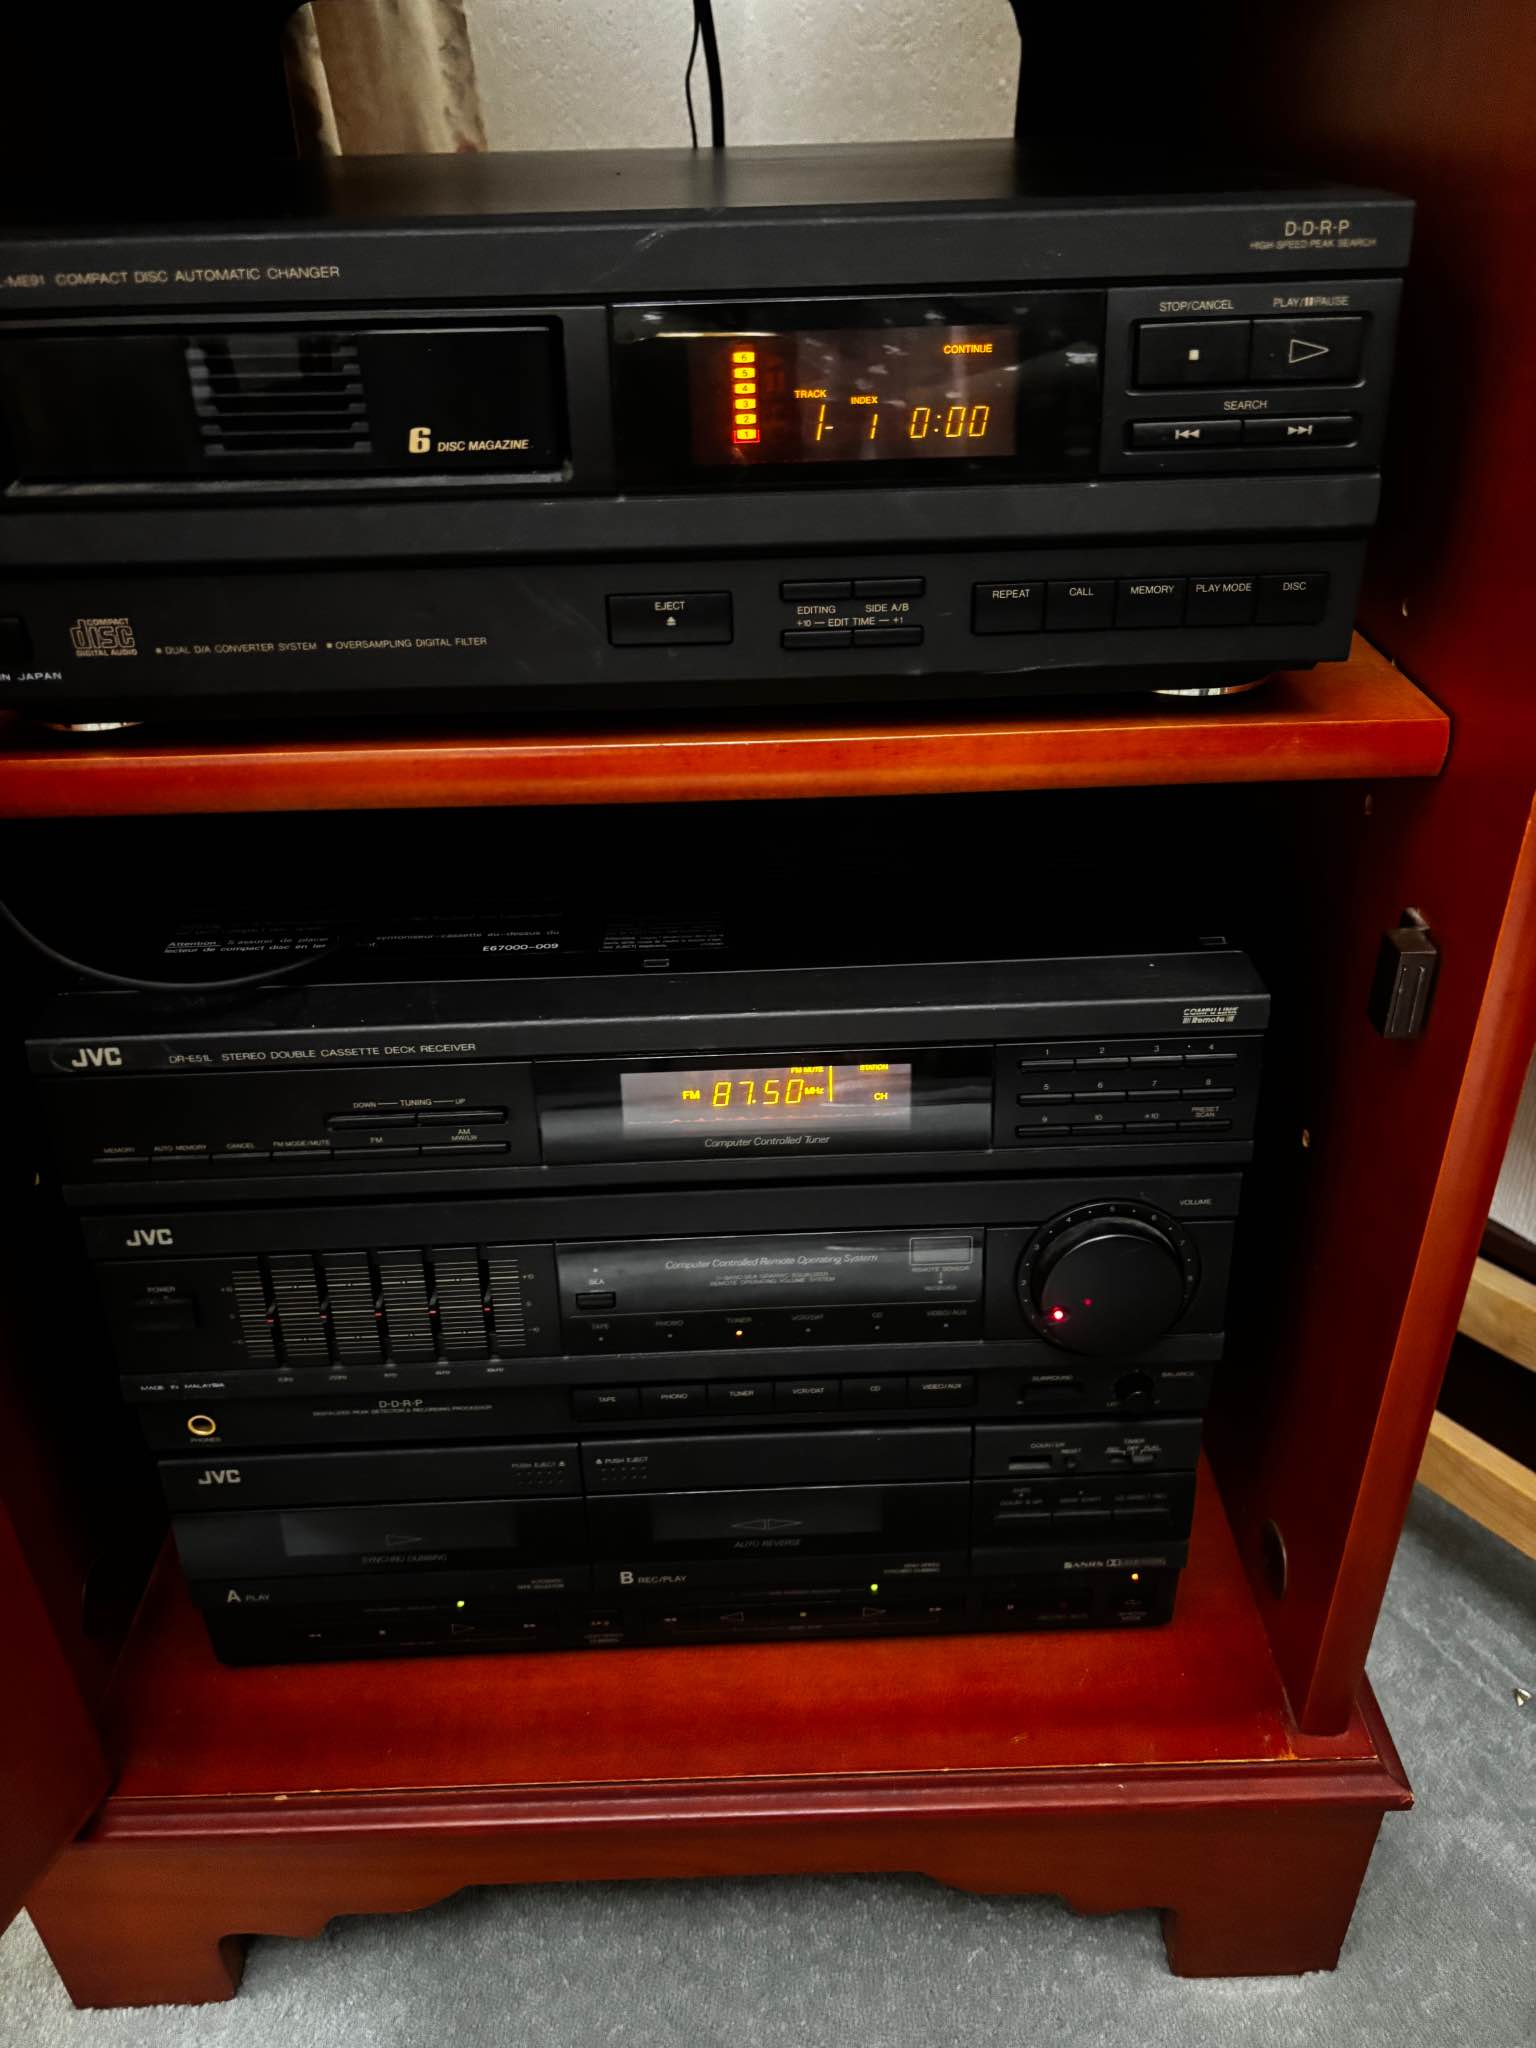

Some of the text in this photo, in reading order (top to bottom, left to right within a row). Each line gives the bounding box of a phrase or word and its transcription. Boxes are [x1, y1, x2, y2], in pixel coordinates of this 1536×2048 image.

[54, 271, 129, 287] COMPACT
[133, 269, 169, 284] DISC
[175, 267, 261, 283] AUTOMATIC
[266, 265, 341, 281] CHANGER
[1159, 299, 1235, 312] STOP/CANCEL
[943, 343, 993, 355] CONTINUE
[794, 389, 827, 399] TRACK
[850, 396, 878, 405] INDEX
[1223, 400, 1268, 411] SEARCH
[909, 405, 990, 439] 0:00
[408, 427, 530, 454] 6 DISC MAGAZINE
[1068, 586, 1095, 598] CALL
[1130, 584, 1176, 595] MEMORY
[1195, 582, 1252, 593] PLAY MODE
[1282, 580, 1307, 592] DISC
[992, 588, 1031, 600] REPEAT
[654, 601, 685, 612] EJECT
[797, 605, 837, 615] EDITING
[865, 602, 910, 613] SIDE A/B
[827, 618, 849, 627] EDIT
[853, 616, 876, 626] TIME
[164, 641, 318, 655] DUAL D/A CONVERTER SYSTEM
[335, 635, 488, 650] OVERSAMPLING DIGITAL FILTER
[75, 648, 139, 657] DIGITAL AUDIO
[16, 671, 64, 682] JAPAN
[481, 942, 560, 953] E67000-009
[72, 1046, 123, 1068] JVC
[221, 1051, 267, 1063] STEREO
[271, 1049, 317, 1061] DOUBLE
[320, 1046, 381, 1058] CASSETTE
[384, 1045, 417, 1056] DECK
[419, 1043, 477, 1053] RECEIVER
[859, 1063, 889, 1071] STATION
[682, 1077, 824, 1107] FM 87.50 MHz
[873, 1091, 888, 1101] CH
[352, 1097, 467, 1109] DOWN TUNING UP
[457, 1128, 471, 1136] AM
[704, 1134, 831, 1149] Computer Controlled Tuner
[125, 1227, 174, 1247] JVC
[664, 1253, 880, 1271] Computer Controlled Remote Operating System
[659, 1392, 689, 1401] PHONO
[197, 1468, 242, 1486] JVC
[618, 1570, 635, 1585] B
[226, 1588, 242, 1604] A
